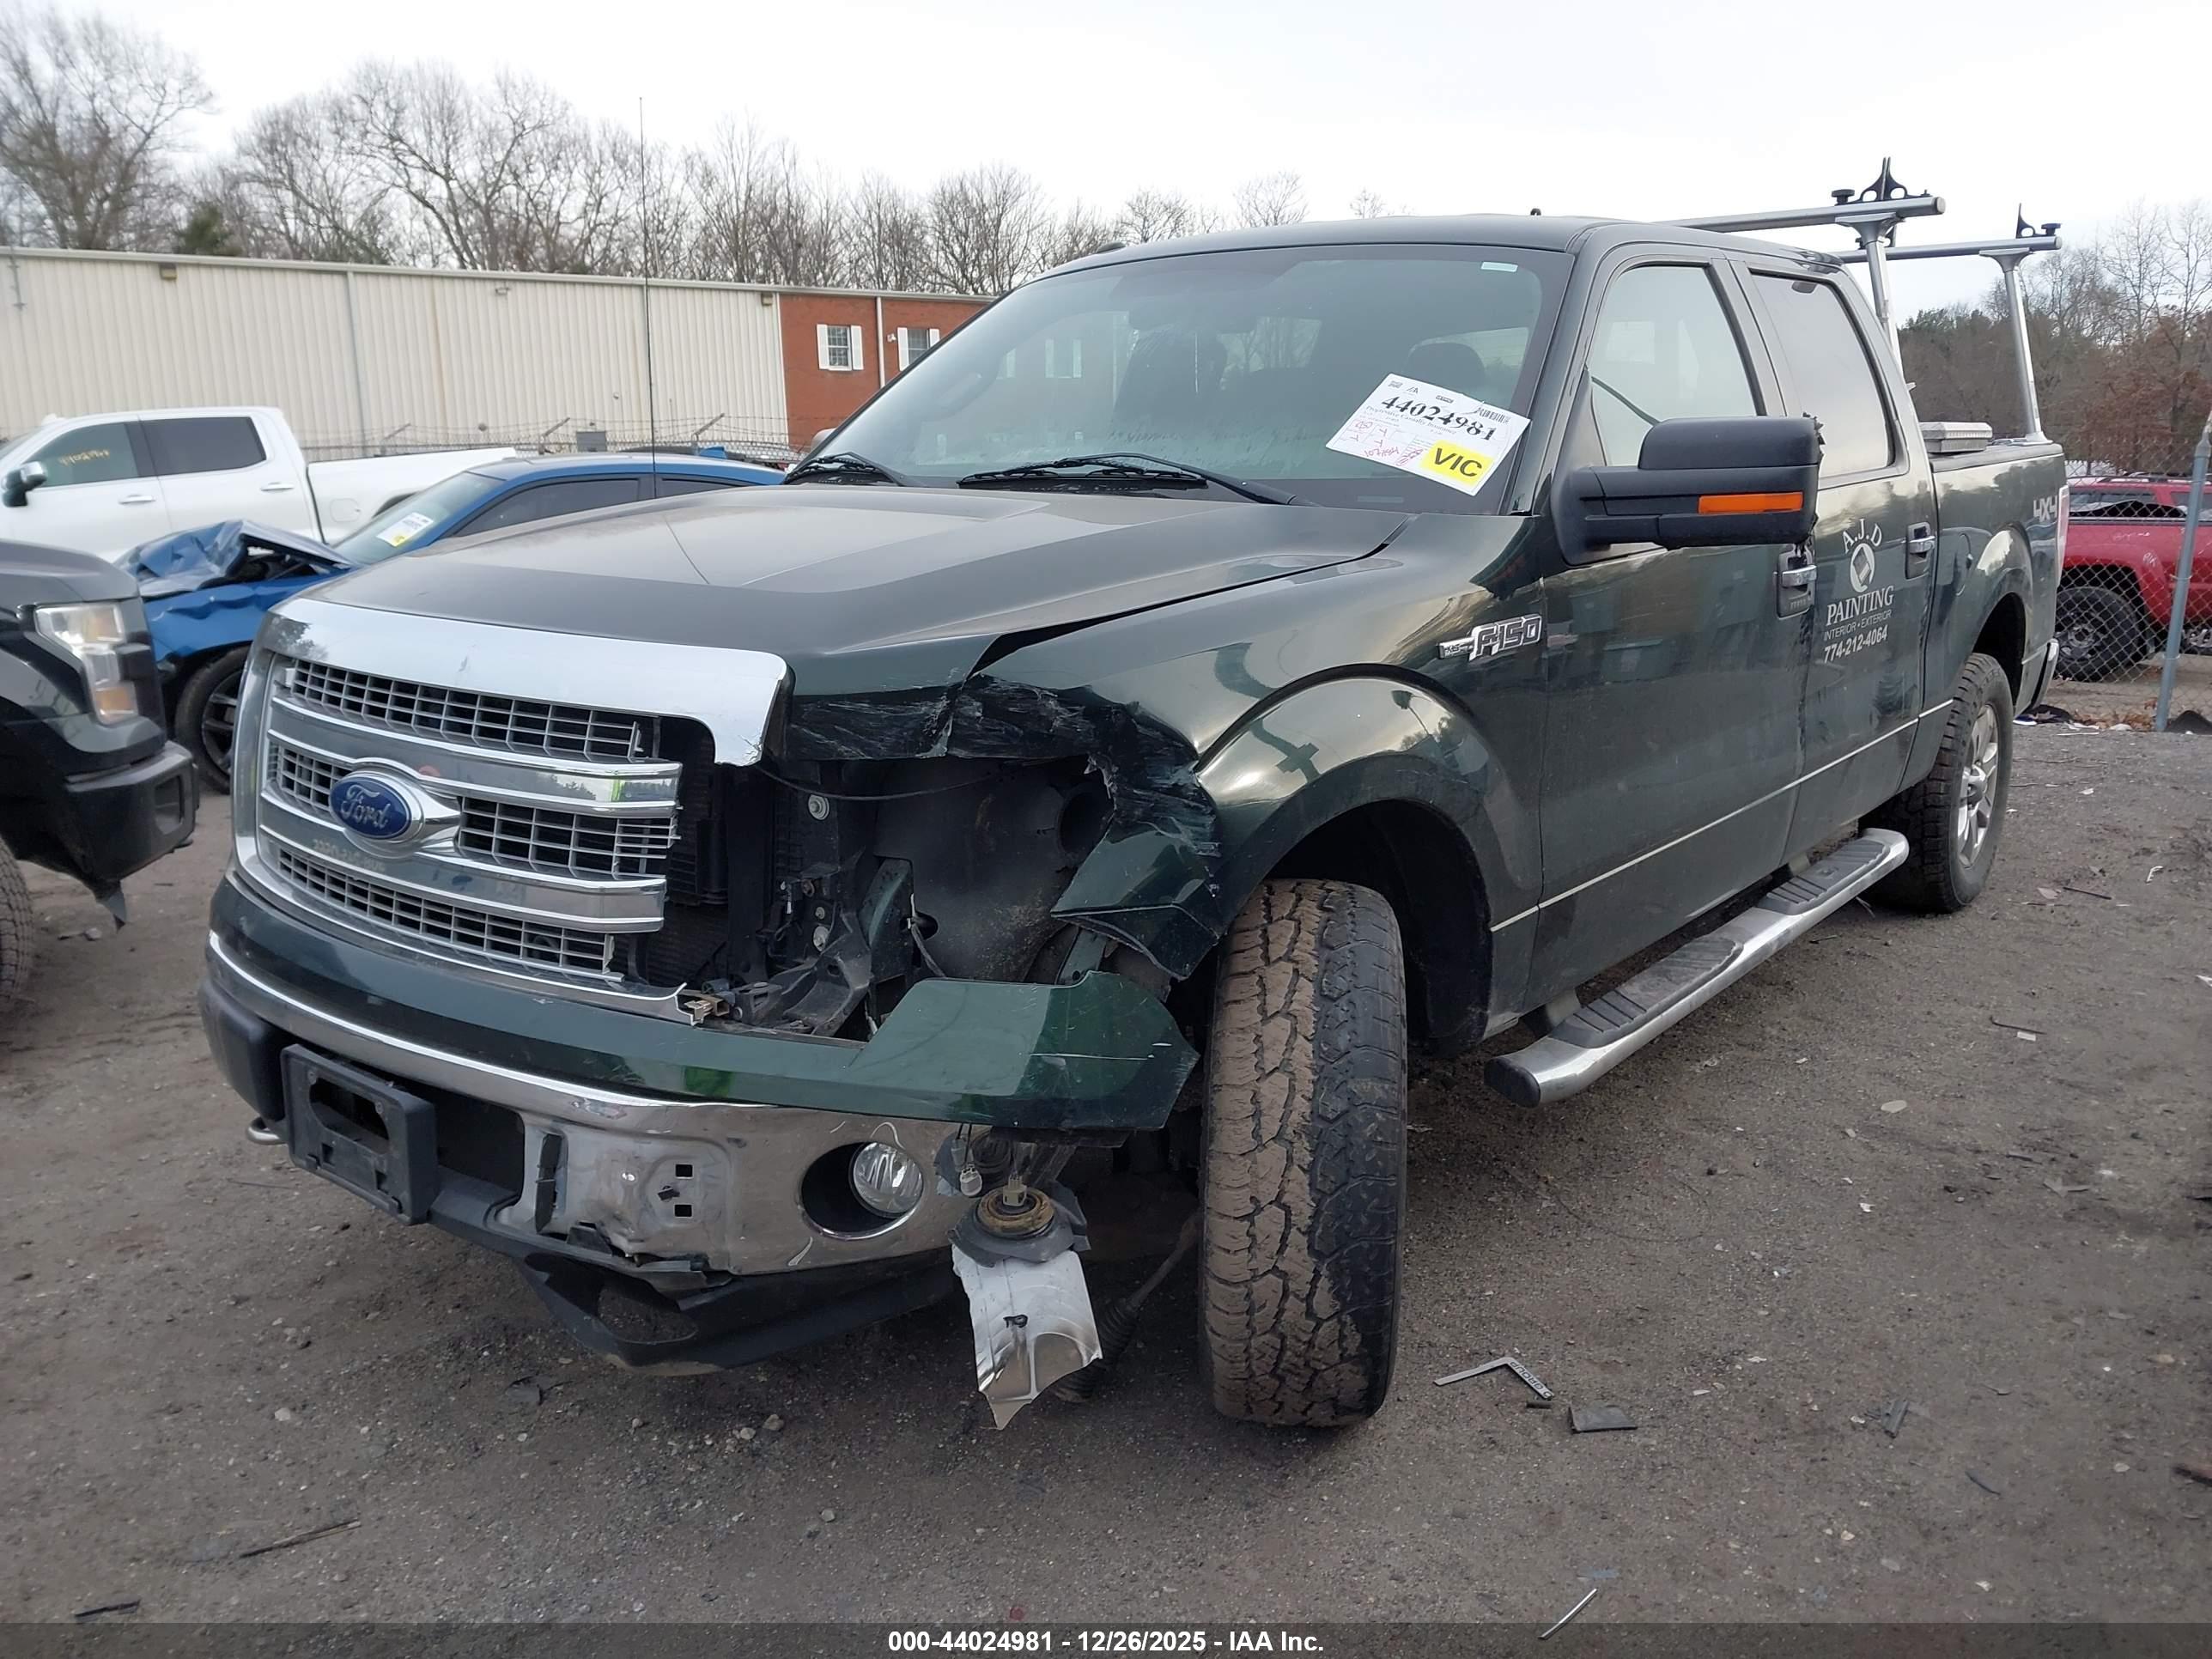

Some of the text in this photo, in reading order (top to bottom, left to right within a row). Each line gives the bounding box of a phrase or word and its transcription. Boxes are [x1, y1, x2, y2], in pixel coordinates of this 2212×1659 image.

[1381, 396, 1497, 441] 44024981
[1433, 447, 1483, 477] VIC
[1824, 610, 1893, 641] INTERIOR EXTERIOR
[1826, 585, 1894, 626] PAINTING
[1824, 624, 1888, 663] 774-212-4064
[339, 783, 391, 829] Ford
